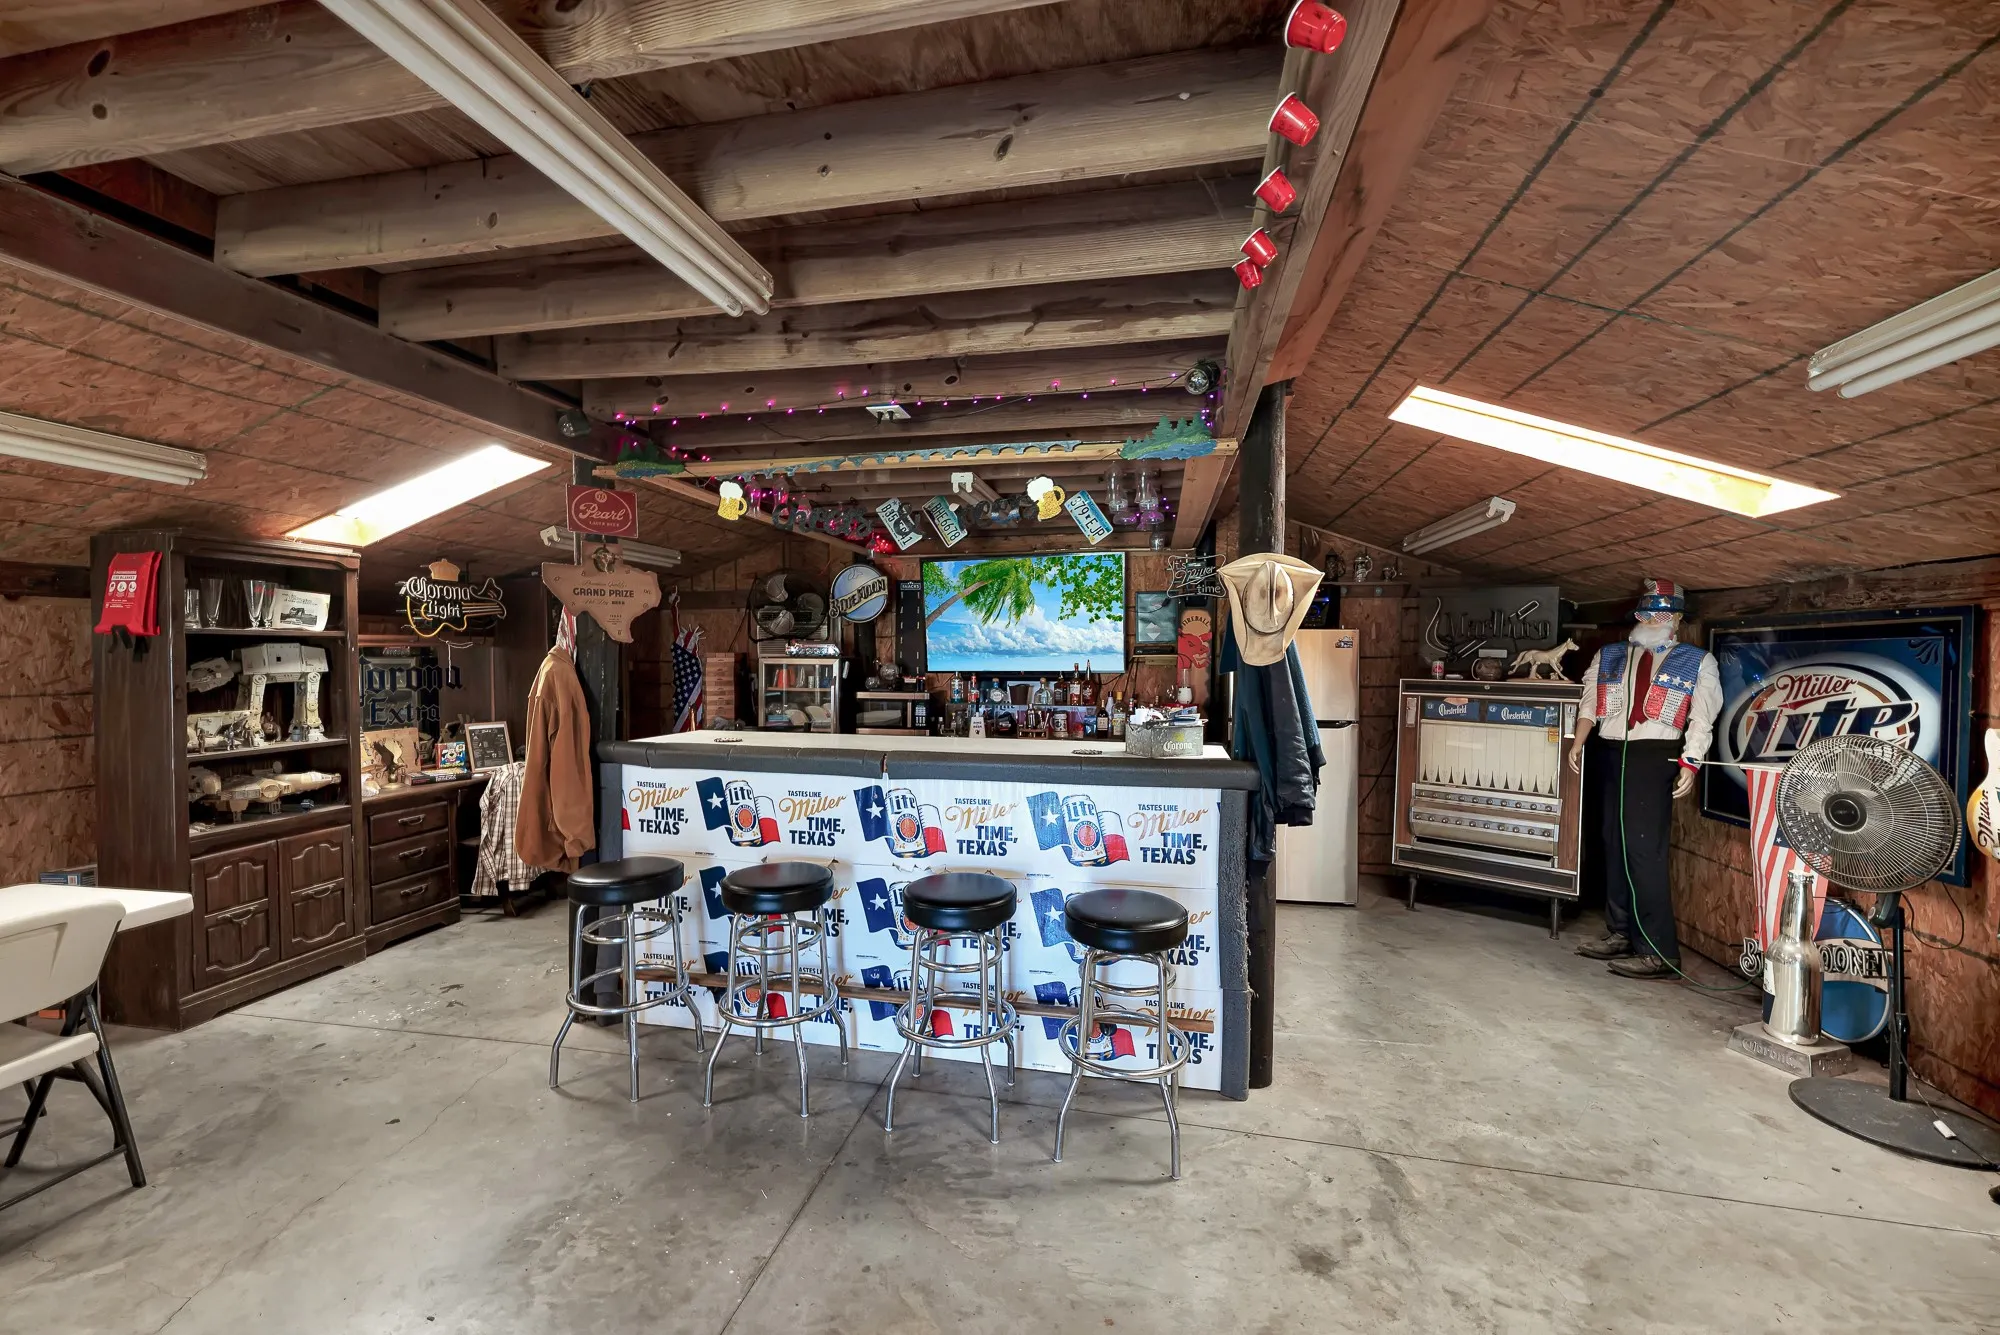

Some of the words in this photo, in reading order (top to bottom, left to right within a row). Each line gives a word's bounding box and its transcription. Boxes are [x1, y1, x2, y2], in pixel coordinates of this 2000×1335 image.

[579, 502, 626, 520] Pearl
[1085, 518, 1105, 537] EJP
[1172, 560, 1186, 570] It's
[1175, 566, 1216, 584] Miller
[407, 576, 470, 601] Corona
[573, 587, 606, 597] GRAND
[609, 589, 635, 598] PRIZE
[1196, 584, 1220, 594] time
[427, 599, 461, 619] Light
[1182, 615, 1210, 627] FIREBALL
[359, 655, 463, 706] orona
[1775, 673, 1858, 702] Miller
[368, 696, 440, 726] Extra
[1438, 703, 1467, 716] Chesterfield
[1500, 706, 1532, 720] Chesterfield
[1163, 740, 1193, 752] Corona
[628, 785, 690, 812] Miller
[729, 786, 752, 805] Lite
[890, 795, 915, 814] Lite
[955, 797, 976, 805] TASTES
[653, 806, 689, 824] TIME,
[778, 795, 847, 824] Miller
[1066, 801, 1095, 822] Lite
[1138, 803, 1162, 811] TASTES
[1163, 804, 1178, 812] LIKE
[806, 816, 846, 834] TIME,
[945, 801, 1019, 833] Miller
[1127, 808, 1208, 840] Miller
[1977, 790, 1995, 848] Miller
[638, 818, 680, 835] TEXAS
[975, 825, 1018, 843] TIME,
[789, 829, 836, 846] TEXAS
[1161, 832, 1207, 851] TIME,
[956, 839, 1008, 856] TEXAS
[1139, 847, 1196, 865] TEXAS
[893, 888, 903, 907] Li
[643, 952, 662, 960] TASTES
[1167, 949, 1199, 966] XAS
[962, 981, 980, 989] TASTE
[1170, 1002, 1185, 1010] LIKE
